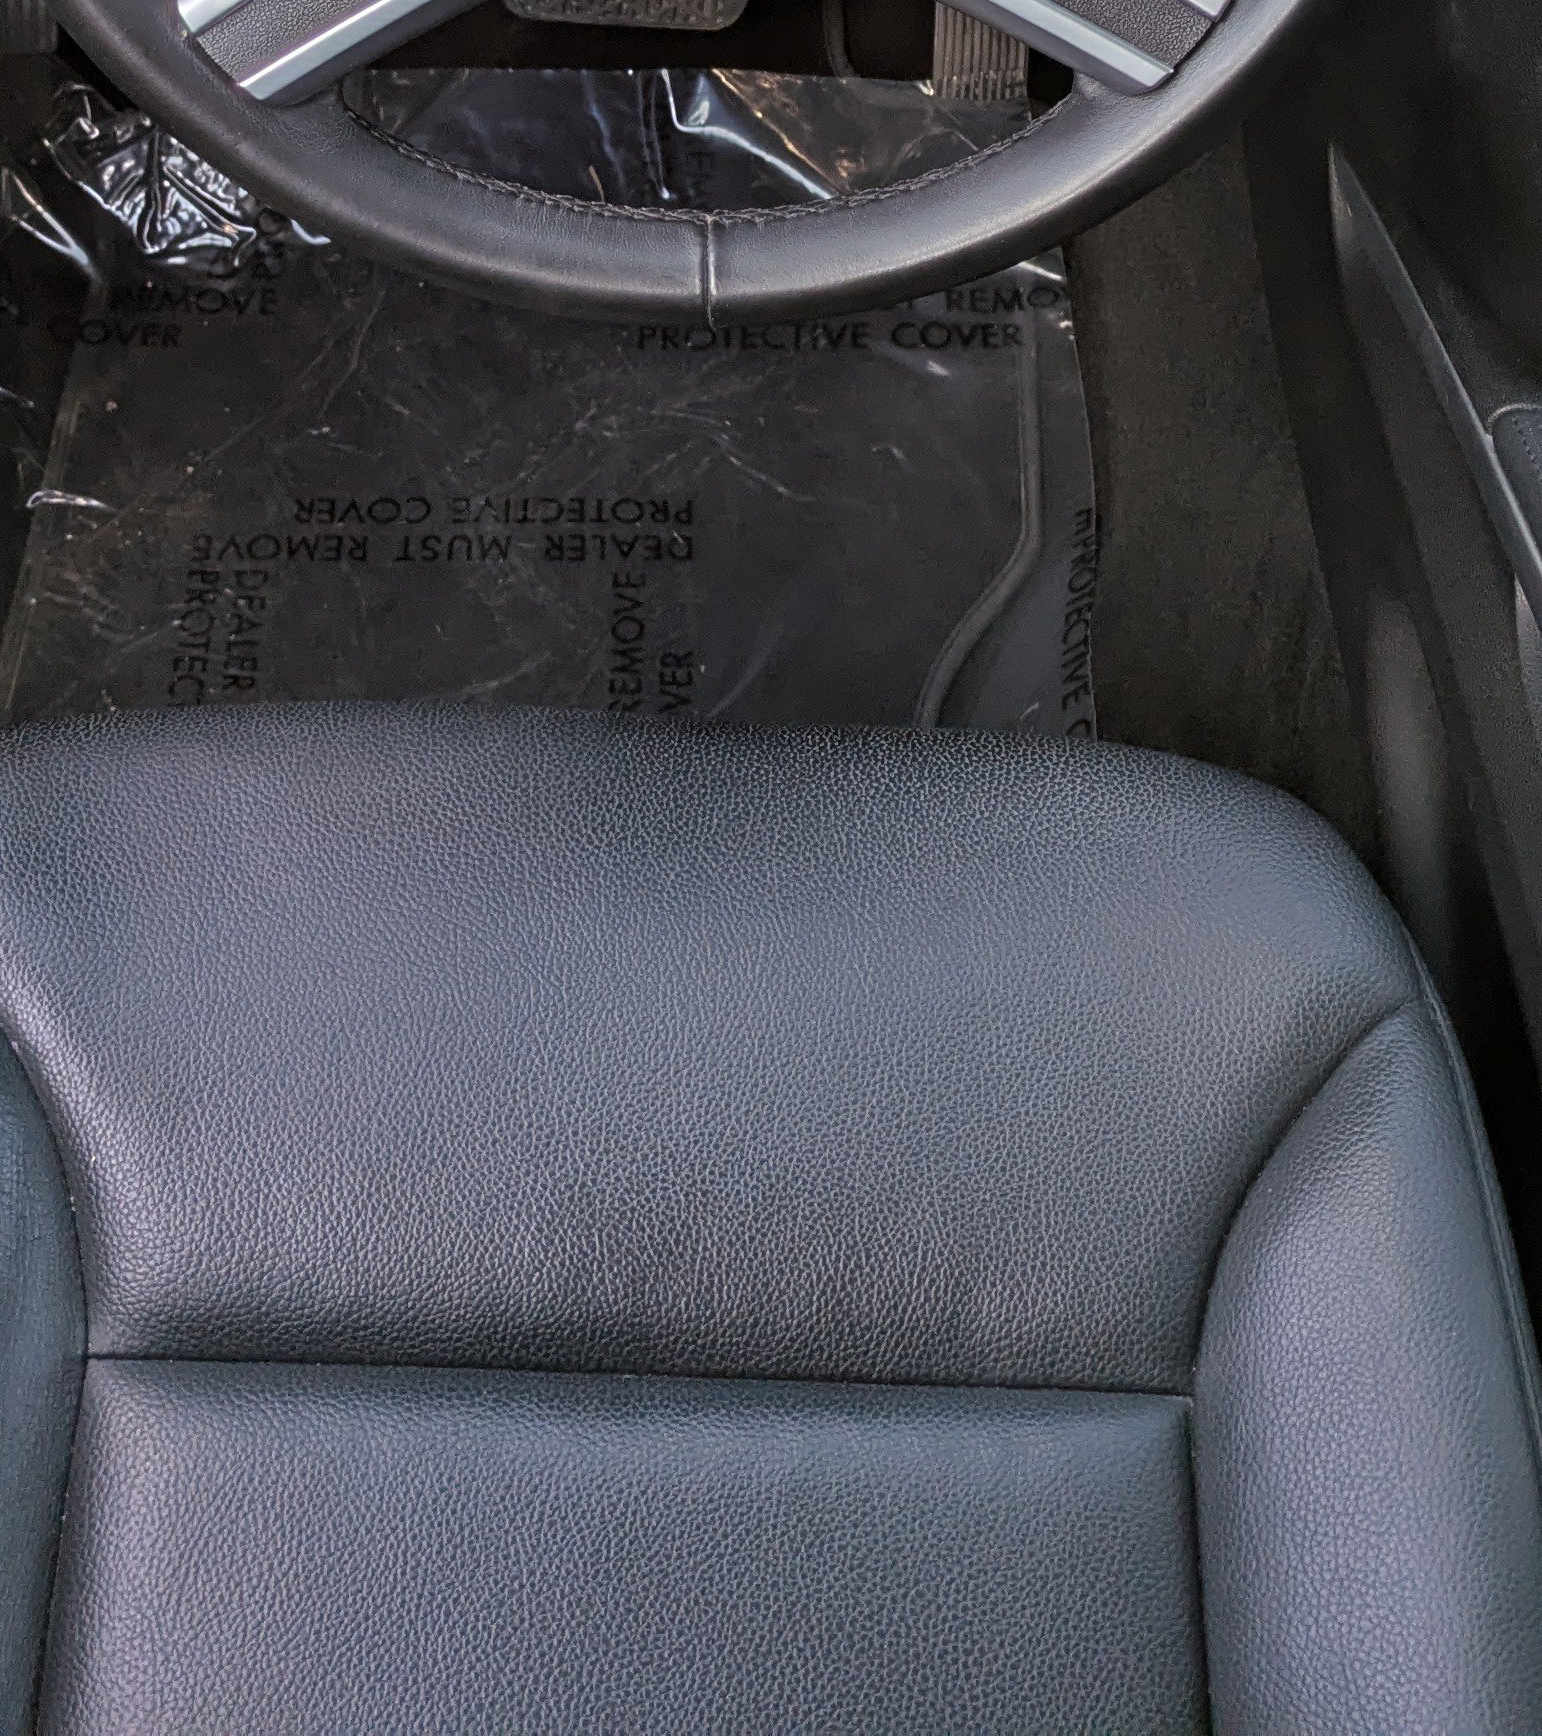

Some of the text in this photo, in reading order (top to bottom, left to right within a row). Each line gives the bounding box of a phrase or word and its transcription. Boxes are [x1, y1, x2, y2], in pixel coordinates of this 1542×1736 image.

[637, 321, 1024, 351] PROTECTIVE COVER
[293, 495, 694, 527] PROTECTIVE COVER
[191, 532, 694, 564] DEALER MUST REMOVE
[223, 569, 270, 691] DEALER
